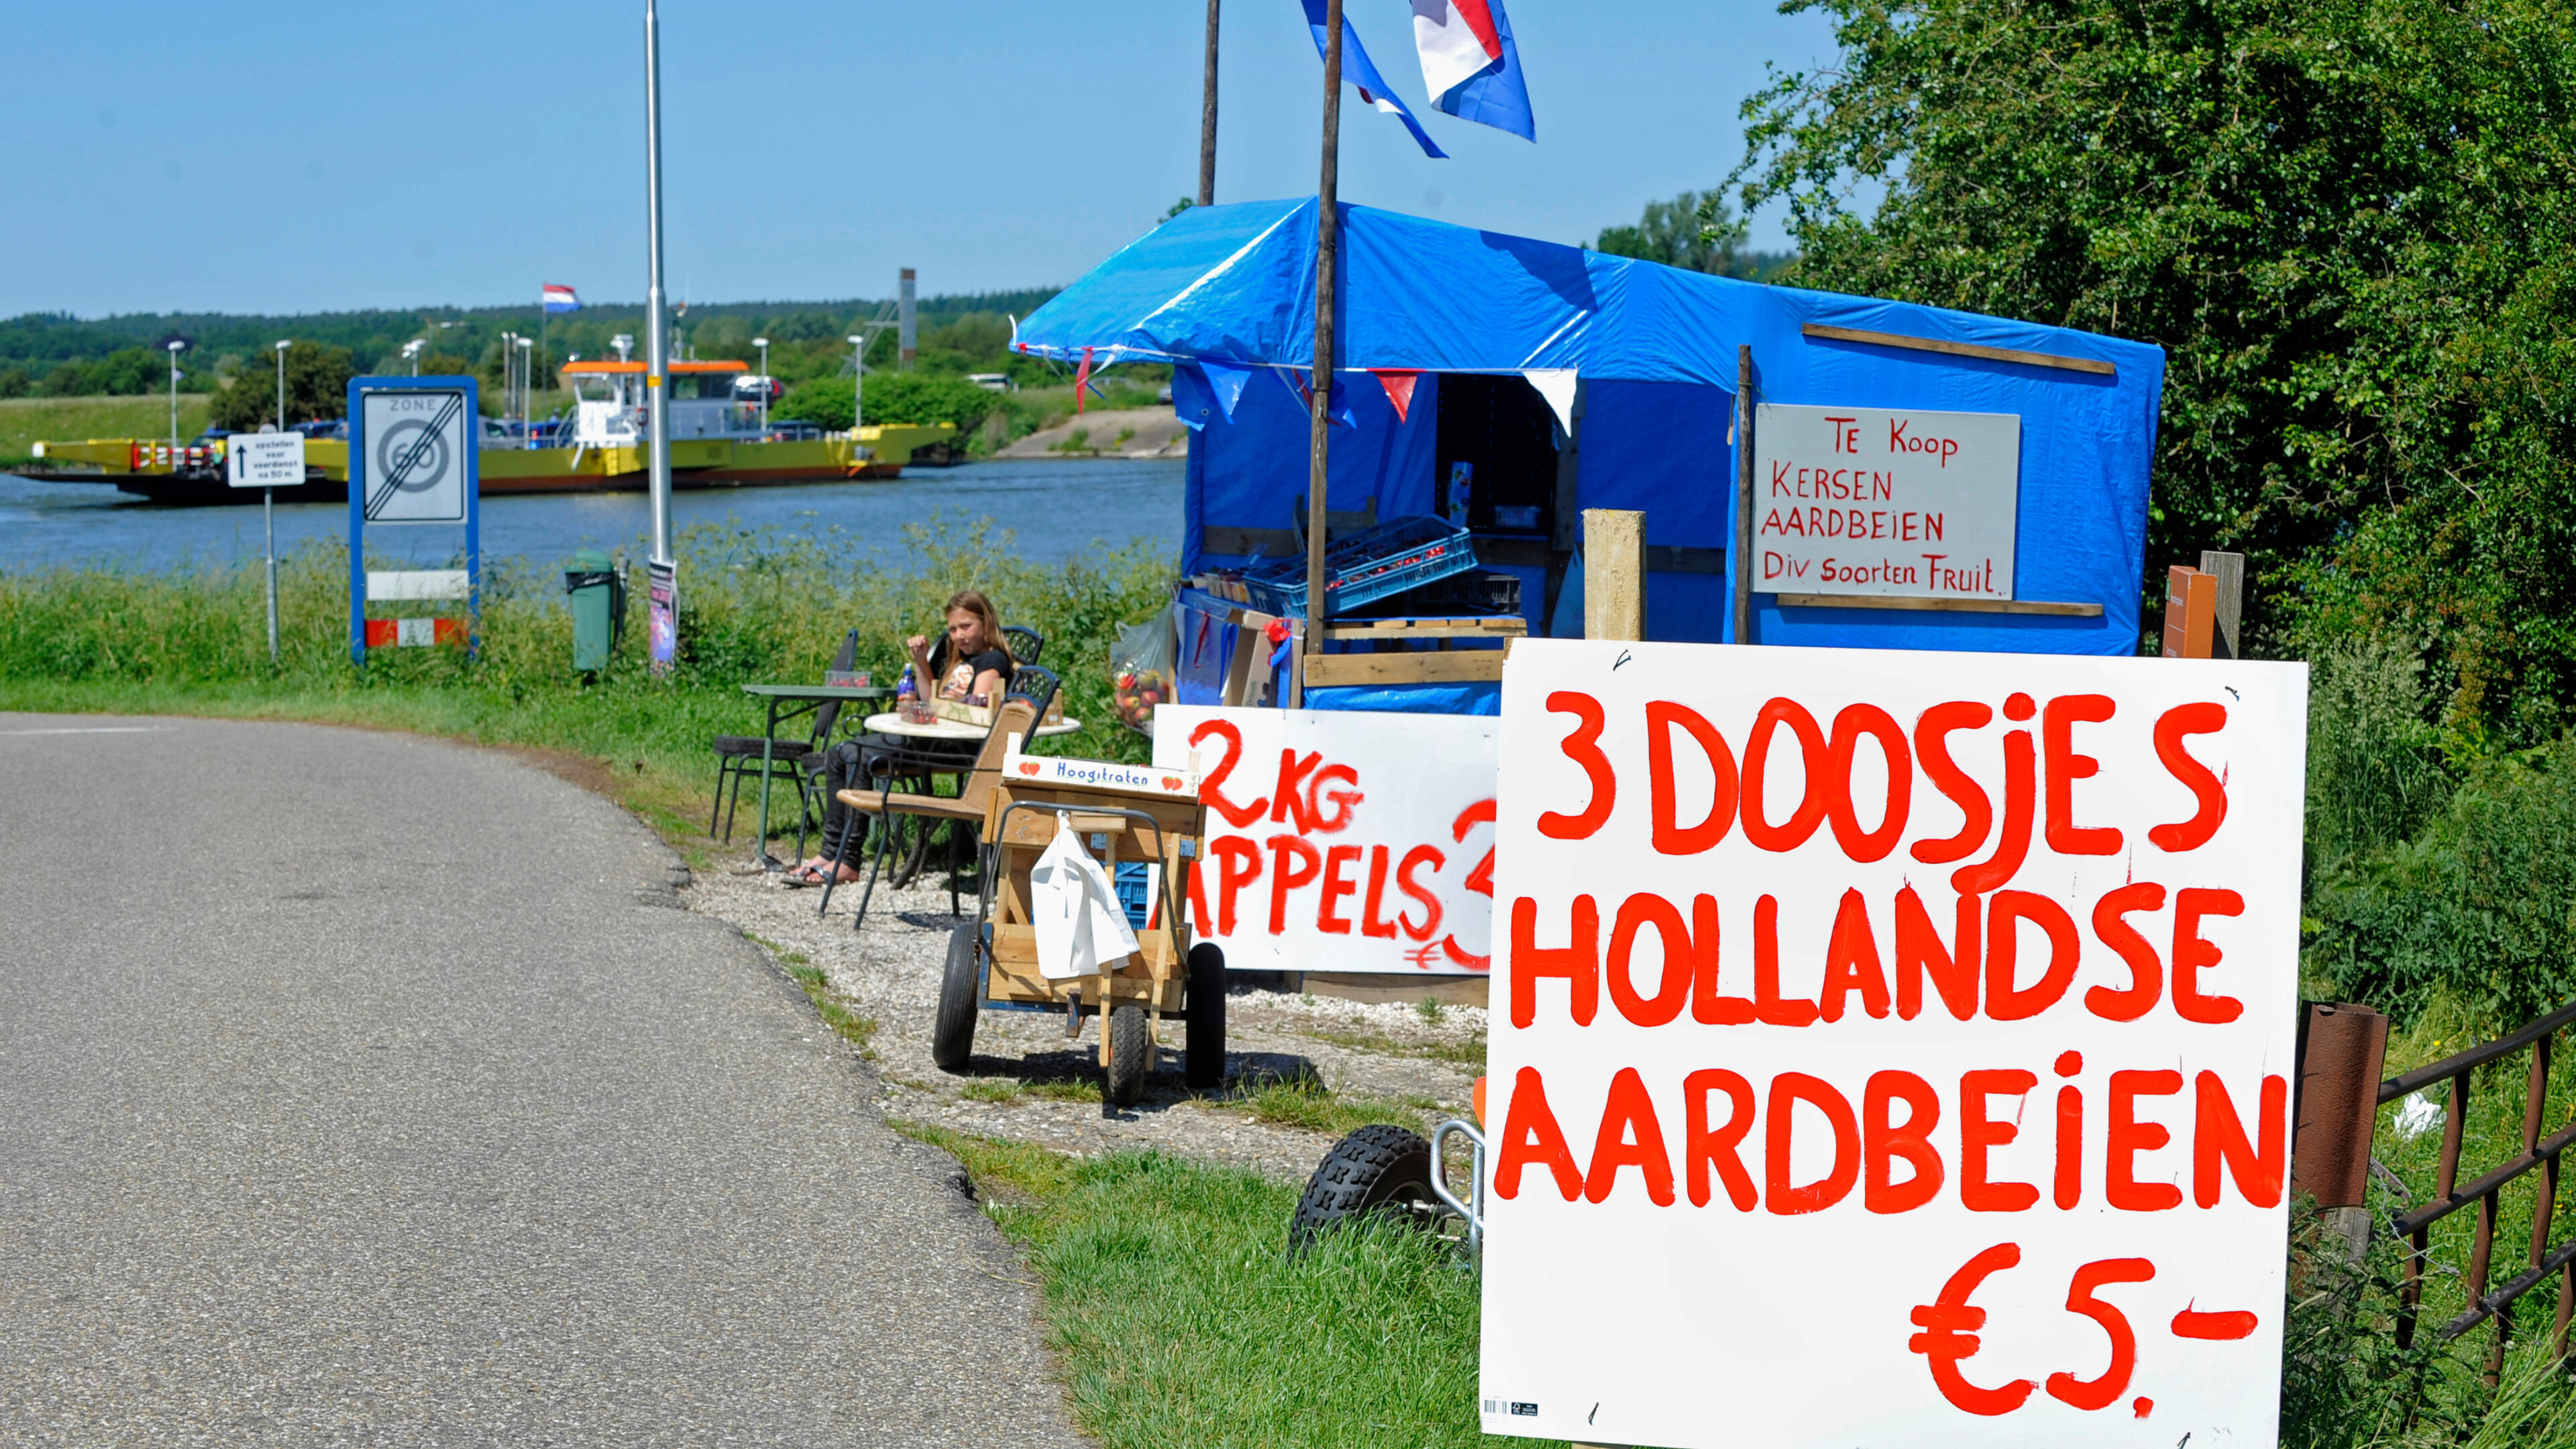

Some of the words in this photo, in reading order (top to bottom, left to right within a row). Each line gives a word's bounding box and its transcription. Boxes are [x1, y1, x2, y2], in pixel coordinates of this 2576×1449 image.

[390, 398, 436, 411] ZONE
[391, 443, 435, 470] 60
[1890, 418, 1959, 468] Koop
[1772, 460, 1892, 501] KERSEN
[1764, 551, 1811, 580] Div
[1189, 719, 1270, 828] 2
[1271, 748, 1364, 837] KG
[1537, 691, 1617, 840] 3
[1510, 881, 2245, 1029] HOLLANDSE
